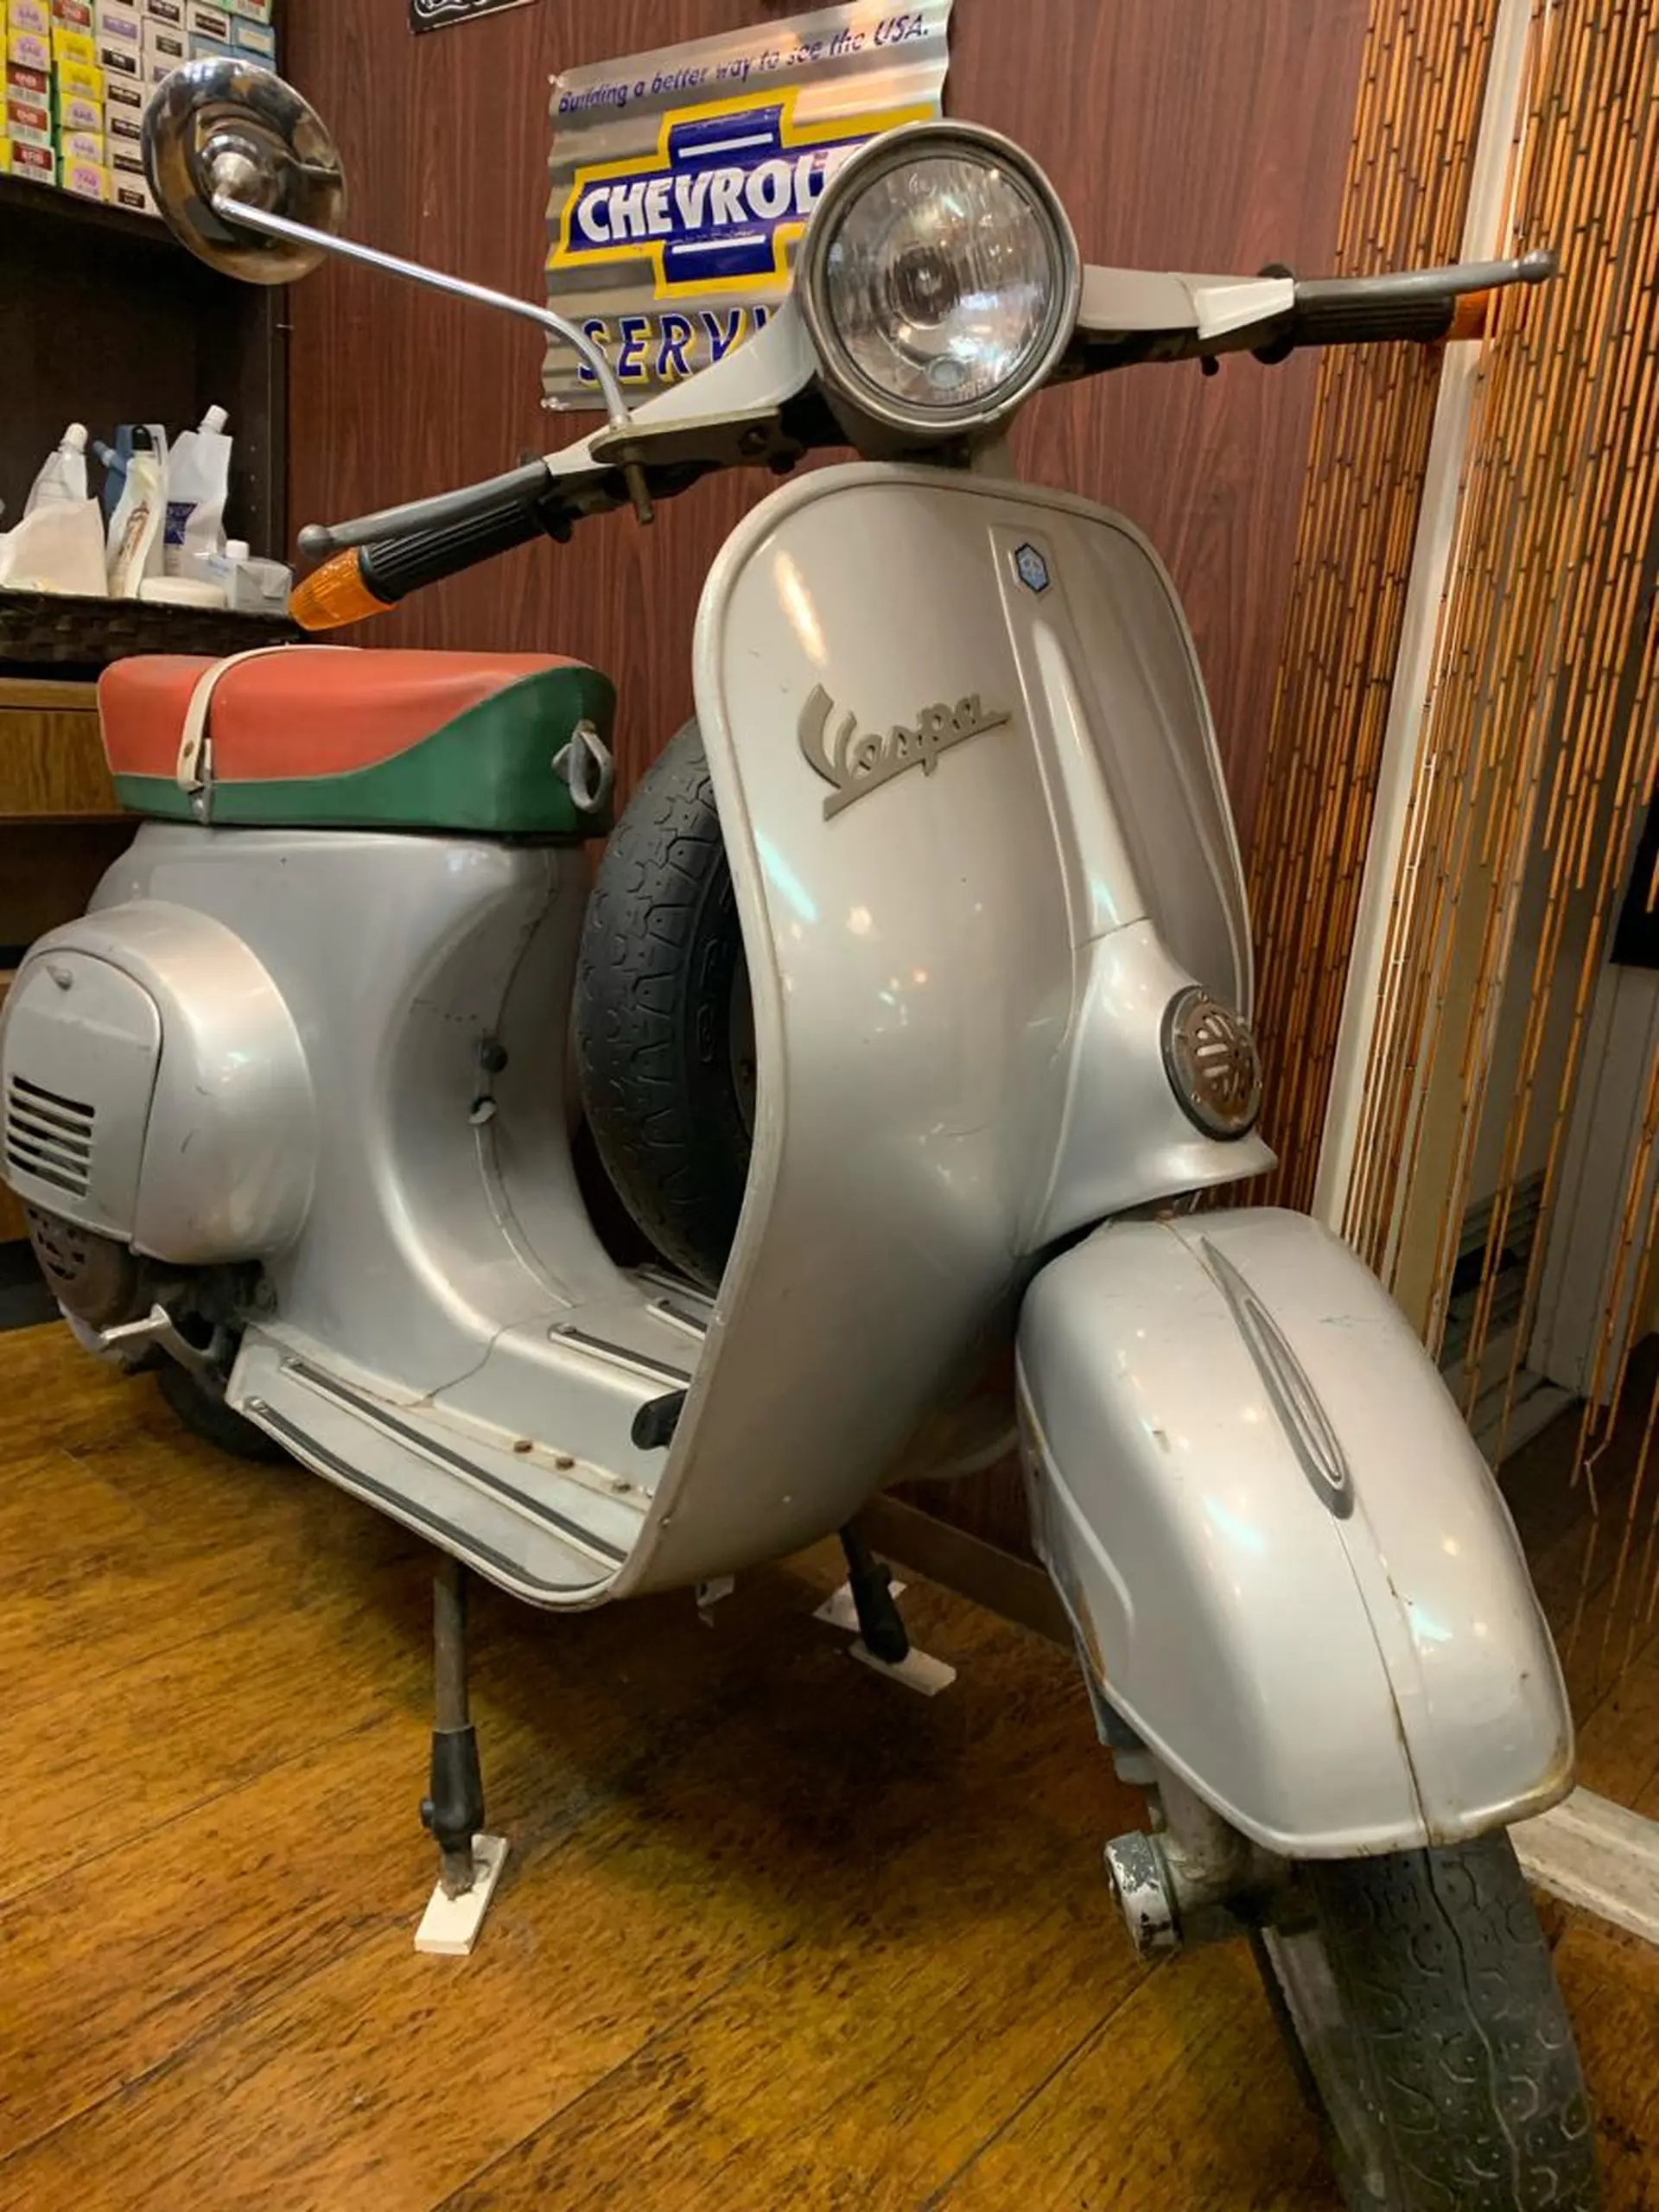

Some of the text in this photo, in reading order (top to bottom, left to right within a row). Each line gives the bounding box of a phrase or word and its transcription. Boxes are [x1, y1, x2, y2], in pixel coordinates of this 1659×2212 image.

[558, 14, 930, 113] Building a better way to see the USA.
[797, 683, 1013, 821] Vespa
